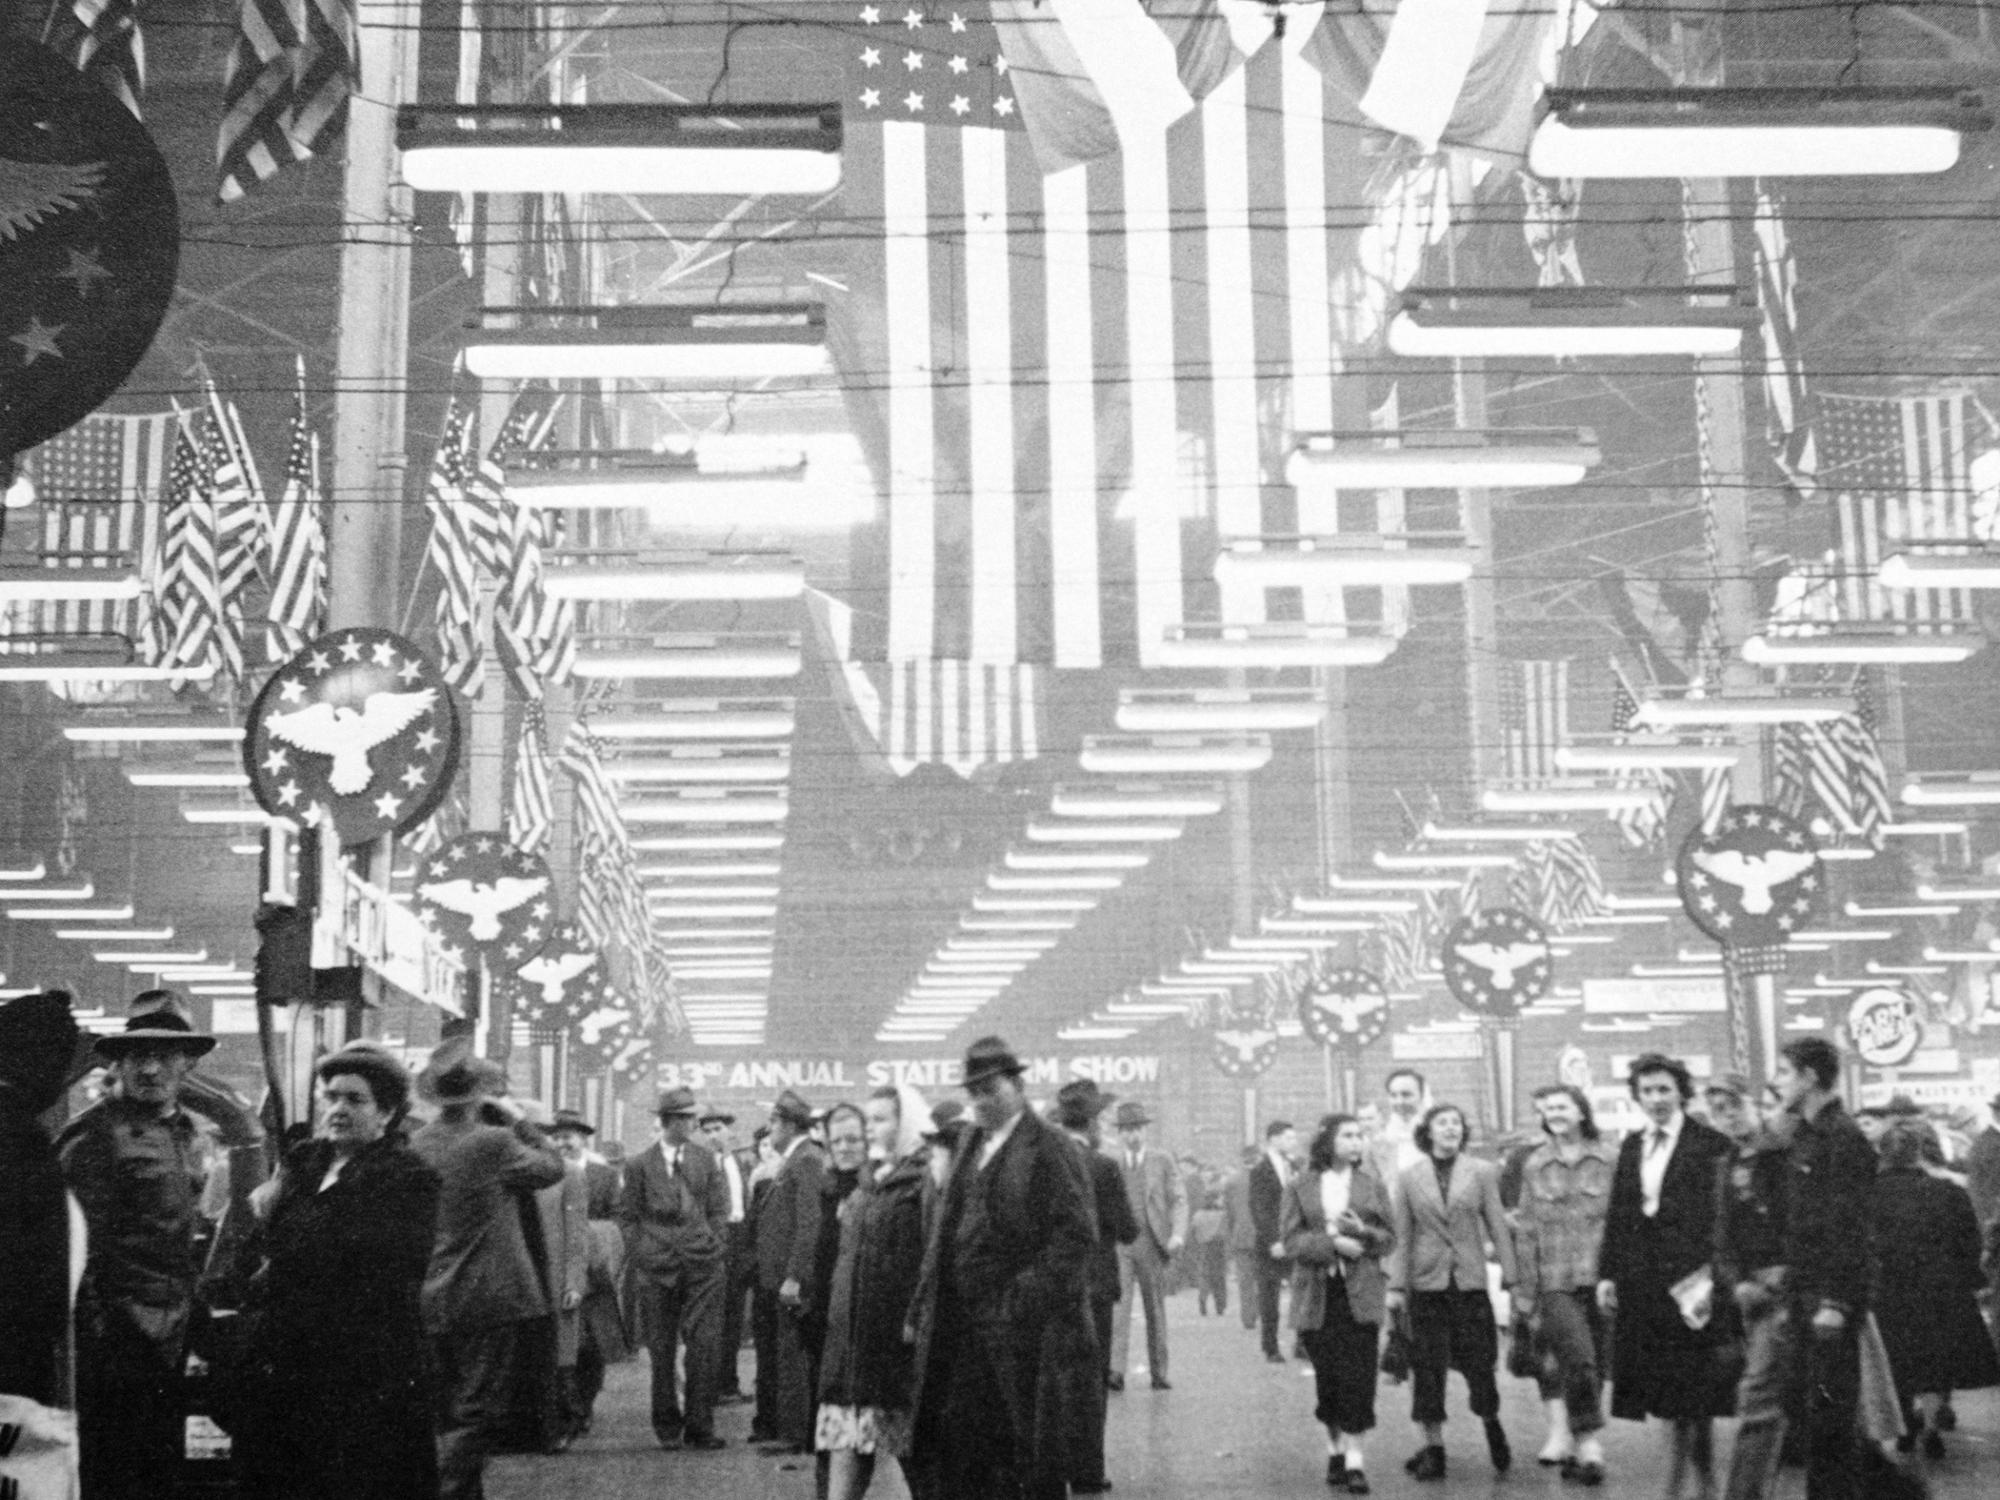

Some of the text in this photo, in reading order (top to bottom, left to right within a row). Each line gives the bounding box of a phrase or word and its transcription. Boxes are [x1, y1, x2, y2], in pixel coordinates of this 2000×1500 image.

[728, 1061, 855, 1087] ANNUAL
[867, 1059, 966, 1087] STATE
[1070, 1057, 1158, 1084] SHOW
